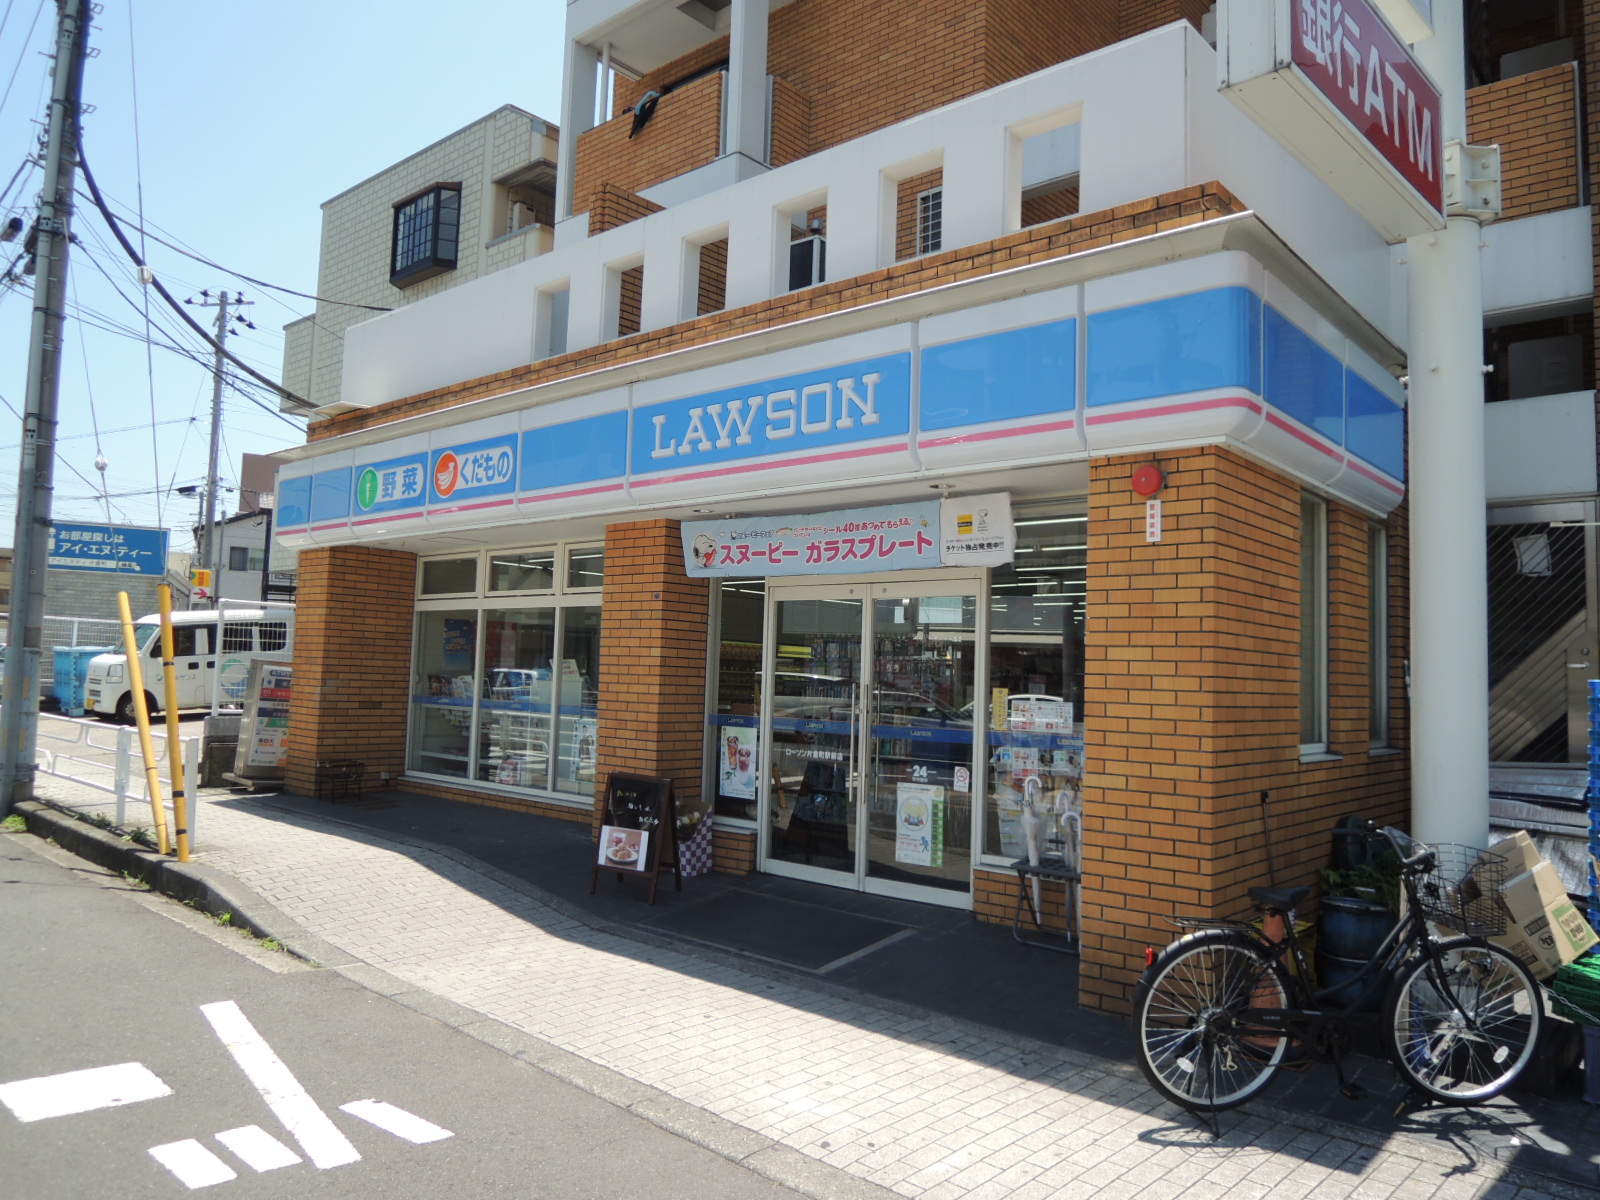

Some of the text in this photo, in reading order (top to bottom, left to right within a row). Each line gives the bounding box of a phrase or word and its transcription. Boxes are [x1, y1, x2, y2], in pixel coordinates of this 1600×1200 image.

[651, 372, 880, 460] LAWSON
[381, 467, 418, 499] 野菜
[460, 451, 511, 485] くだもの
[59, 530, 125, 543] お部屋探しは
[719, 530, 934, 566] スヌーピー ガラスプレート
[913, 764, 928, 778] 24
